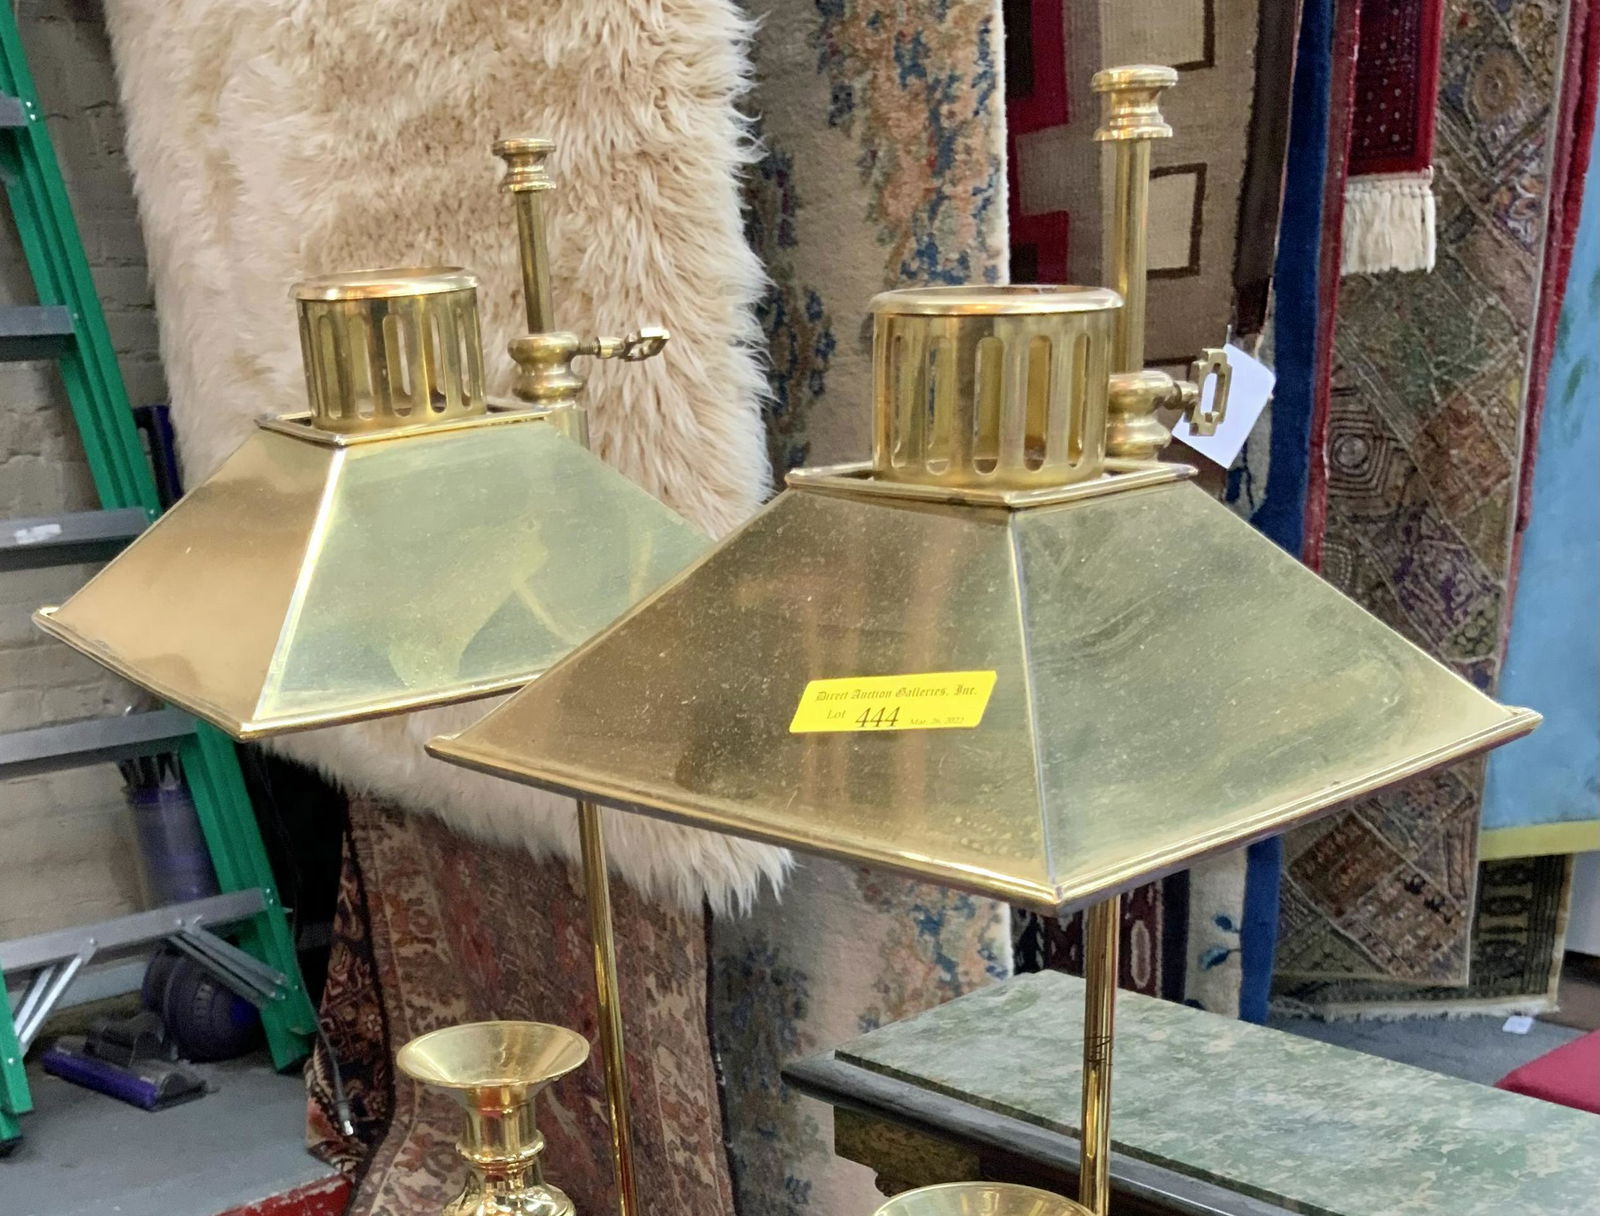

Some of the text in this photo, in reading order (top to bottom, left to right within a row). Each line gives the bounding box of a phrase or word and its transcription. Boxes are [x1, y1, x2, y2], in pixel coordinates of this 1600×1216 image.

[816, 690, 848, 701] Direct
[851, 687, 891, 699] Auction
[954, 683, 977, 696] Inc.
[827, 708, 847, 719] Lot
[855, 706, 901, 728] 444
